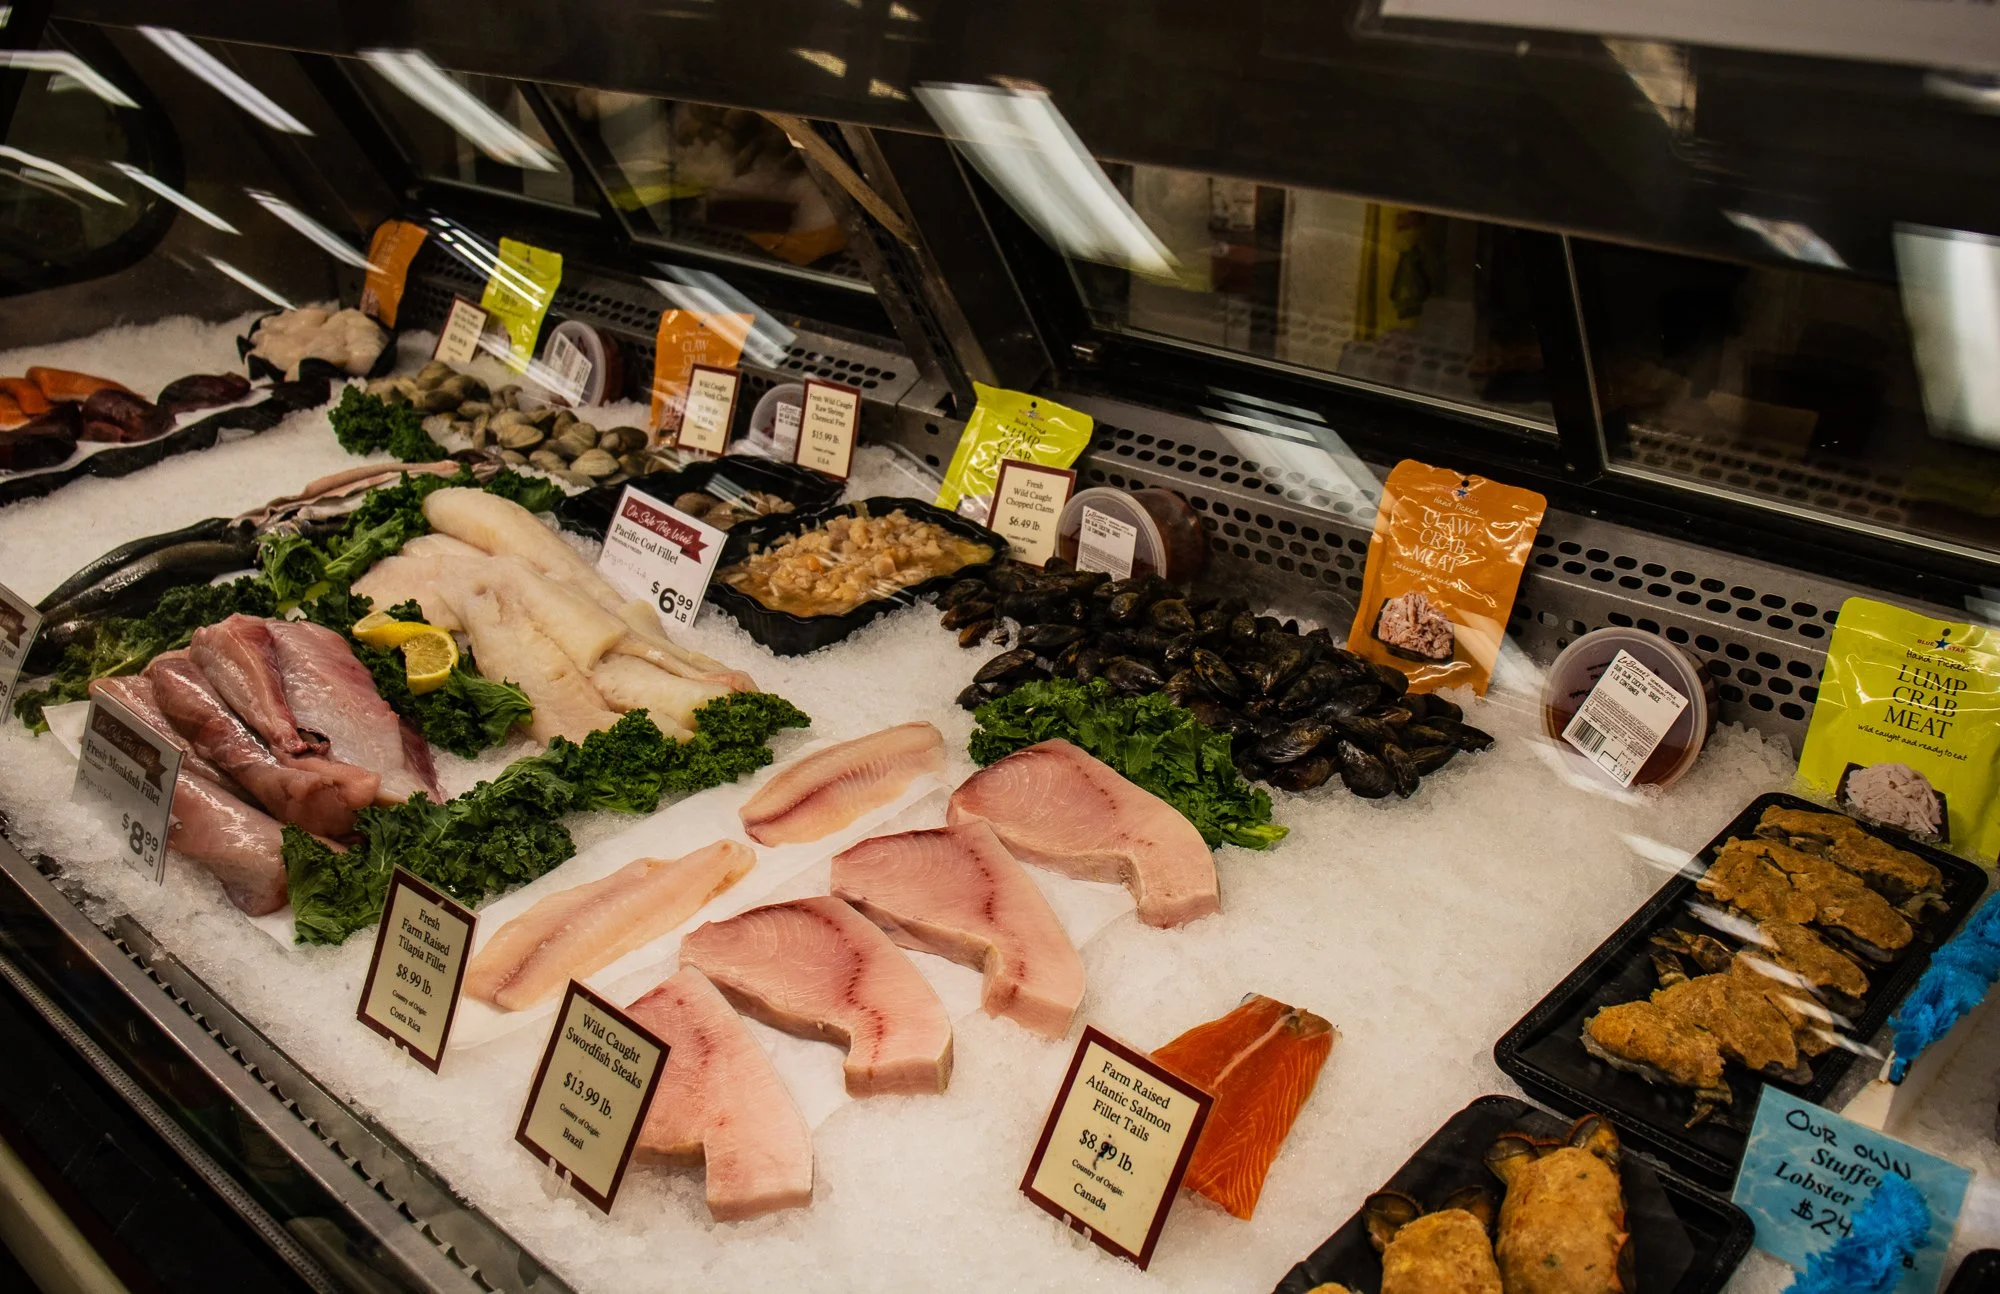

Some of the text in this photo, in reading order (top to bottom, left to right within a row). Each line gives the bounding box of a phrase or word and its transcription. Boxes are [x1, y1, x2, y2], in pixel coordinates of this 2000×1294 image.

[1013, 487, 1053, 503] Wild Caught
[1026, 479, 1044, 489] Fresh
[1005, 496, 1055, 514] Chopped Clams
[1008, 516, 1031, 528] $6.49
[1433, 496, 1480, 516] Hand Picked
[626, 504, 694, 546] On Sale This Week
[1424, 510, 1476, 537] CLAW
[614, 523, 640, 544] Pacific
[640, 537, 656, 553] Cod
[657, 547, 679, 565] Fillet
[1411, 544, 1457, 574] MEAT
[1419, 528, 1466, 556] CRAB
[674, 609, 688, 623] LB
[1906, 649, 1932, 664] Hand
[1917, 638, 1935, 647] BLUE
[1896, 663, 1968, 697] LUMP
[1892, 685, 1958, 718] CRAB
[1883, 705, 1953, 739] MEAT
[1858, 724, 1968, 762] wild caught and ready to eat
[87, 739, 107, 764] Fresh
[109, 755, 141, 790] Monkfish
[140, 780, 160, 807] Fillet
[143, 852, 155, 868] LB
[418, 908, 441, 931] Fresh
[398, 935, 447, 974] Tilapia Fillet
[401, 918, 450, 957] Farm Raised
[395, 963, 433, 998] $8.99 lb.
[390, 1006, 421, 1033] Costa Rica
[583, 1013, 641, 1064] Wild Caught
[566, 1026, 643, 1089] Swordfish Steaks
[563, 1072, 612, 1120] $13.99 lb.
[1101, 1060, 1171, 1110] Farm Raised
[559, 1103, 578, 1121] Country
[577, 1117, 585, 1125] of
[1085, 1074, 1171, 1133] Atlantic Salmon
[1092, 1098, 1150, 1142] Fillet Tails
[562, 1127, 584, 1150] Brazil
[1079, 1128, 1134, 1175] $8.99 lb.
[1785, 1109, 1912, 1180] OUR OWN
[1071, 1159, 1125, 1197] Country of Origin:
[1774, 1161, 1856, 1206] Lobster
[1073, 1182, 1107, 1211] Canada
